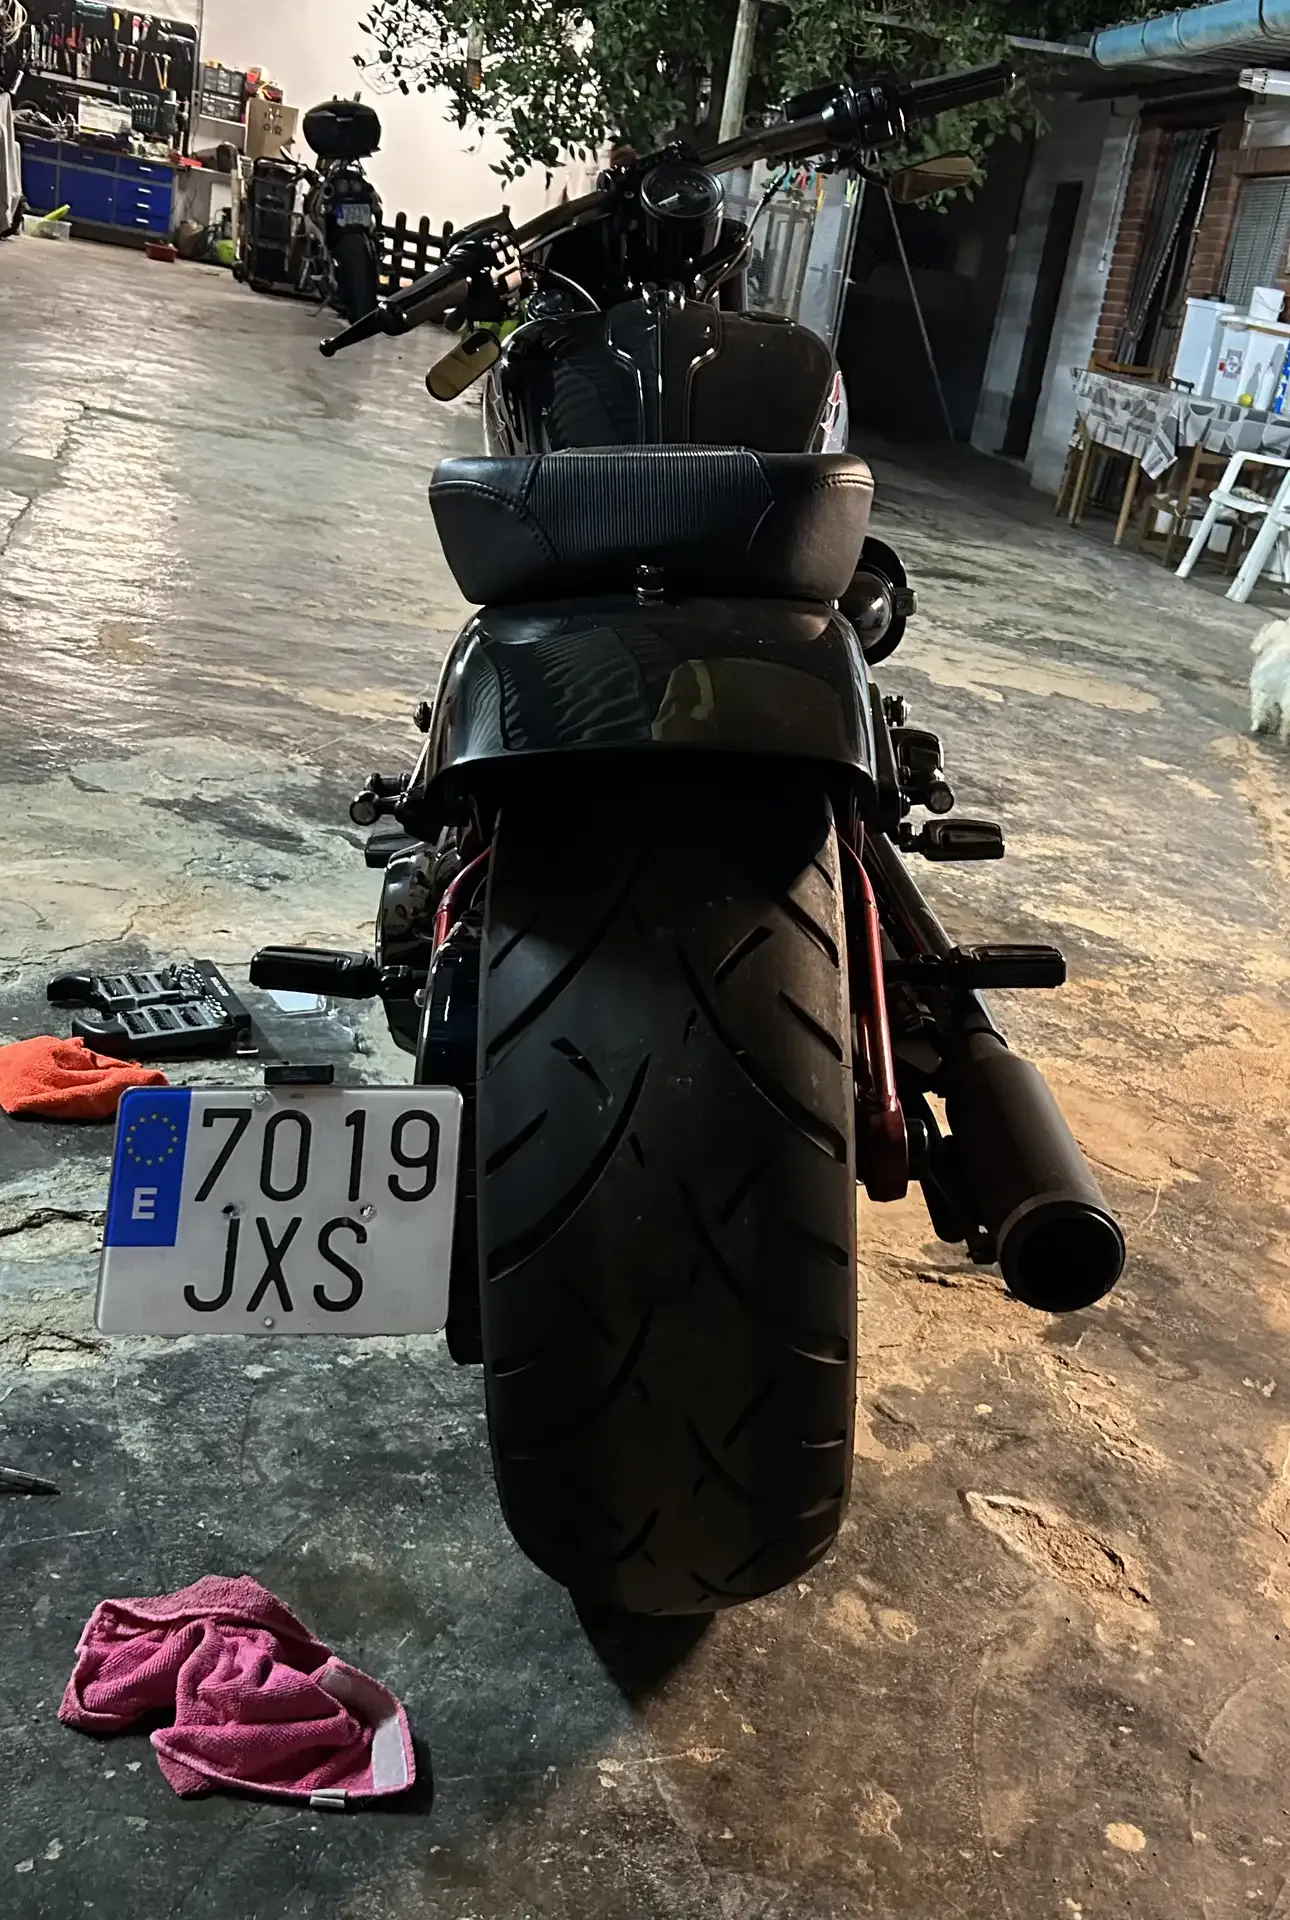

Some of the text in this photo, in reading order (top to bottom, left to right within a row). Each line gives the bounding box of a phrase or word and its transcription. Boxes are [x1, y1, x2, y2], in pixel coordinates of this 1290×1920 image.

[194, 1108, 441, 1202] 7019
[131, 1186, 158, 1220] E
[183, 1216, 368, 1313] JXS
